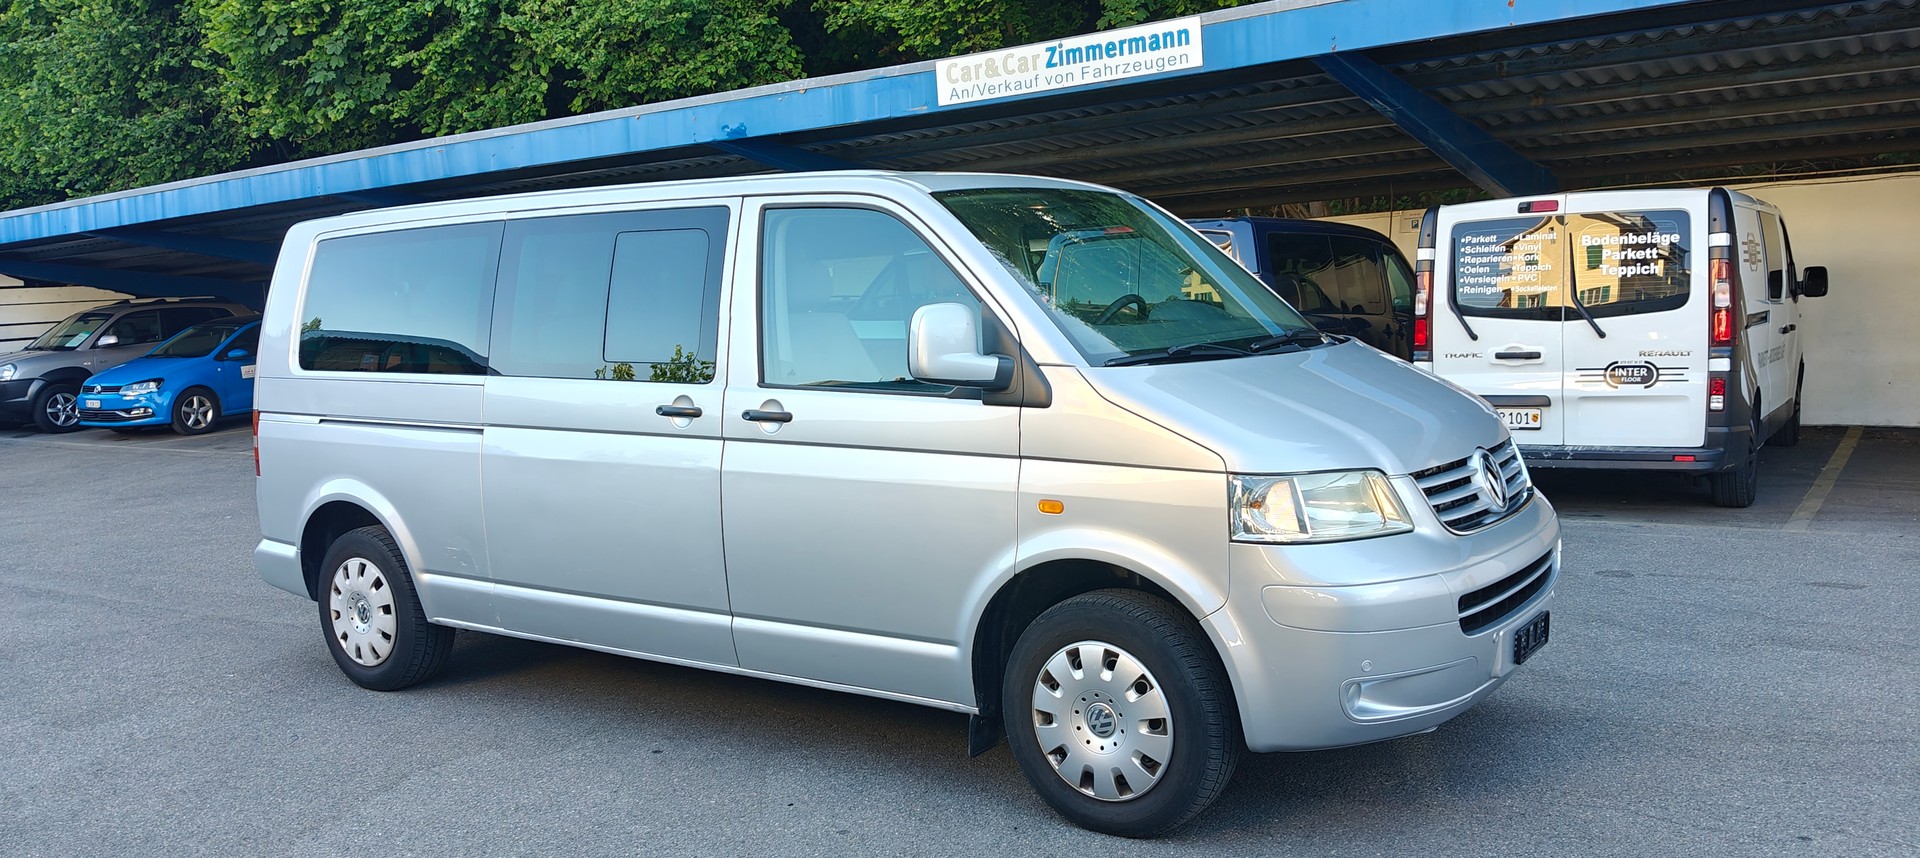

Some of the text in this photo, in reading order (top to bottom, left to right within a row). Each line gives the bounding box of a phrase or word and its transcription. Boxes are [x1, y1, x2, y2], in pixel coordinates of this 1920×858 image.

[946, 28, 1190, 84] Car&Car Zimmermann
[950, 53, 1189, 100] An/Verkauf von Fahrzeugen
[1465, 235, 1497, 244] Parkett
[1519, 232, 1557, 241] Laminat
[1582, 232, 1680, 246] Bodenbeläge
[1465, 244, 1506, 254] Schleifen
[1518, 243, 1541, 252] Vinyl
[1518, 253, 1540, 261] Kork
[1602, 248, 1658, 260] Parkett
[1464, 254, 1513, 265] Reparieren
[1464, 266, 1490, 274] Oelen
[1516, 263, 1551, 273] Teppich
[1600, 263, 1659, 277] Teppich
[1463, 274, 1510, 284] Versiegeln
[1463, 285, 1503, 295] Reinigen
[1615, 367, 1648, 377] INTER
